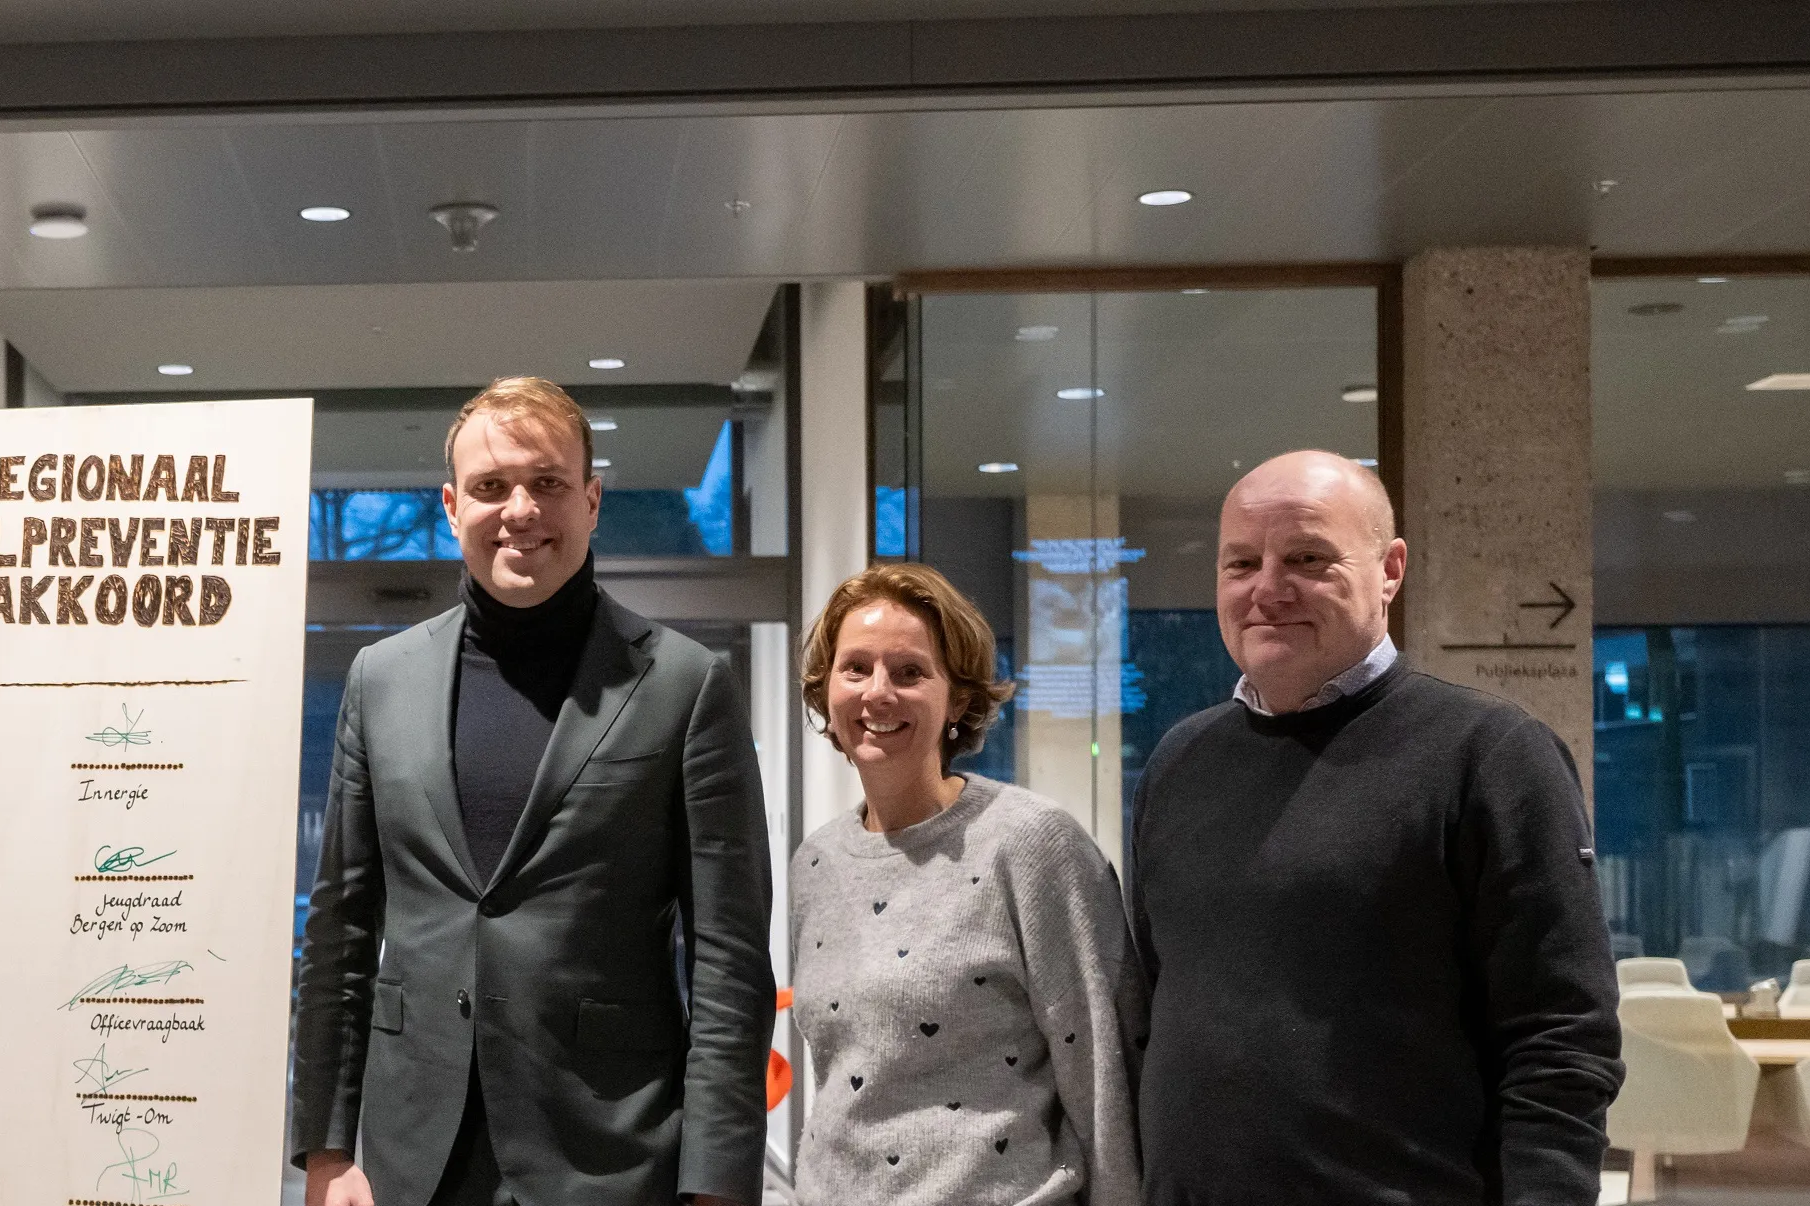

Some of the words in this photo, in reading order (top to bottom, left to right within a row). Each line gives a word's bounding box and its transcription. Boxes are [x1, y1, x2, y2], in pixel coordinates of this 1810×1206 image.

[78, 780, 149, 810] Innergie
[70, 914, 123, 940] Bergen
[130, 921, 143, 941] op
[150, 916, 188, 932] Zoom
[90, 1013, 206, 1043] Officevraagbaak
